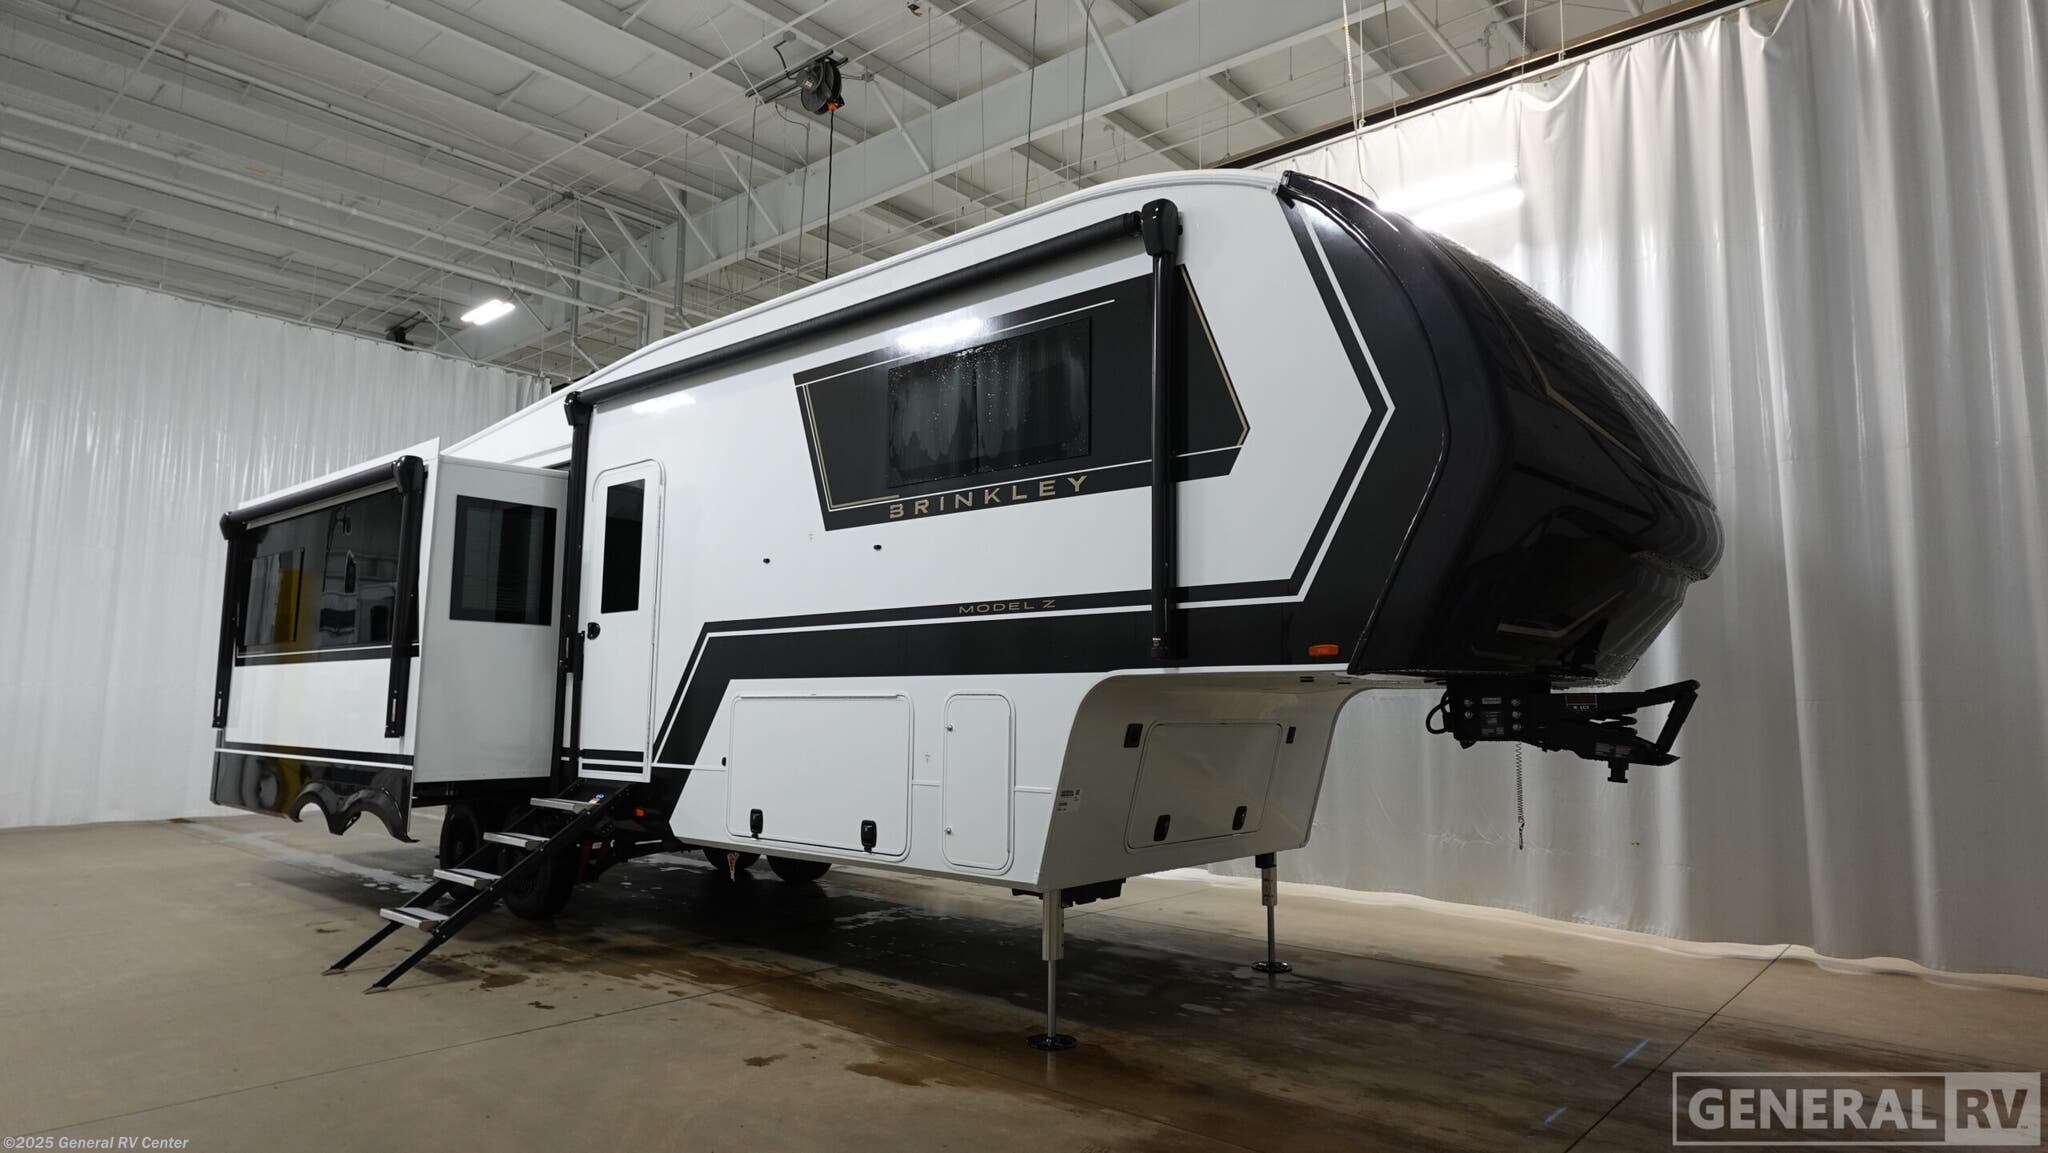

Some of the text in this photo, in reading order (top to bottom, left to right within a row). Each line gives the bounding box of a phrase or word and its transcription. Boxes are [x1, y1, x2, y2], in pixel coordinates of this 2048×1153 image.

[889, 475, 1088, 519] BRINKLEY
[959, 600, 1056, 614] MODEL Z
